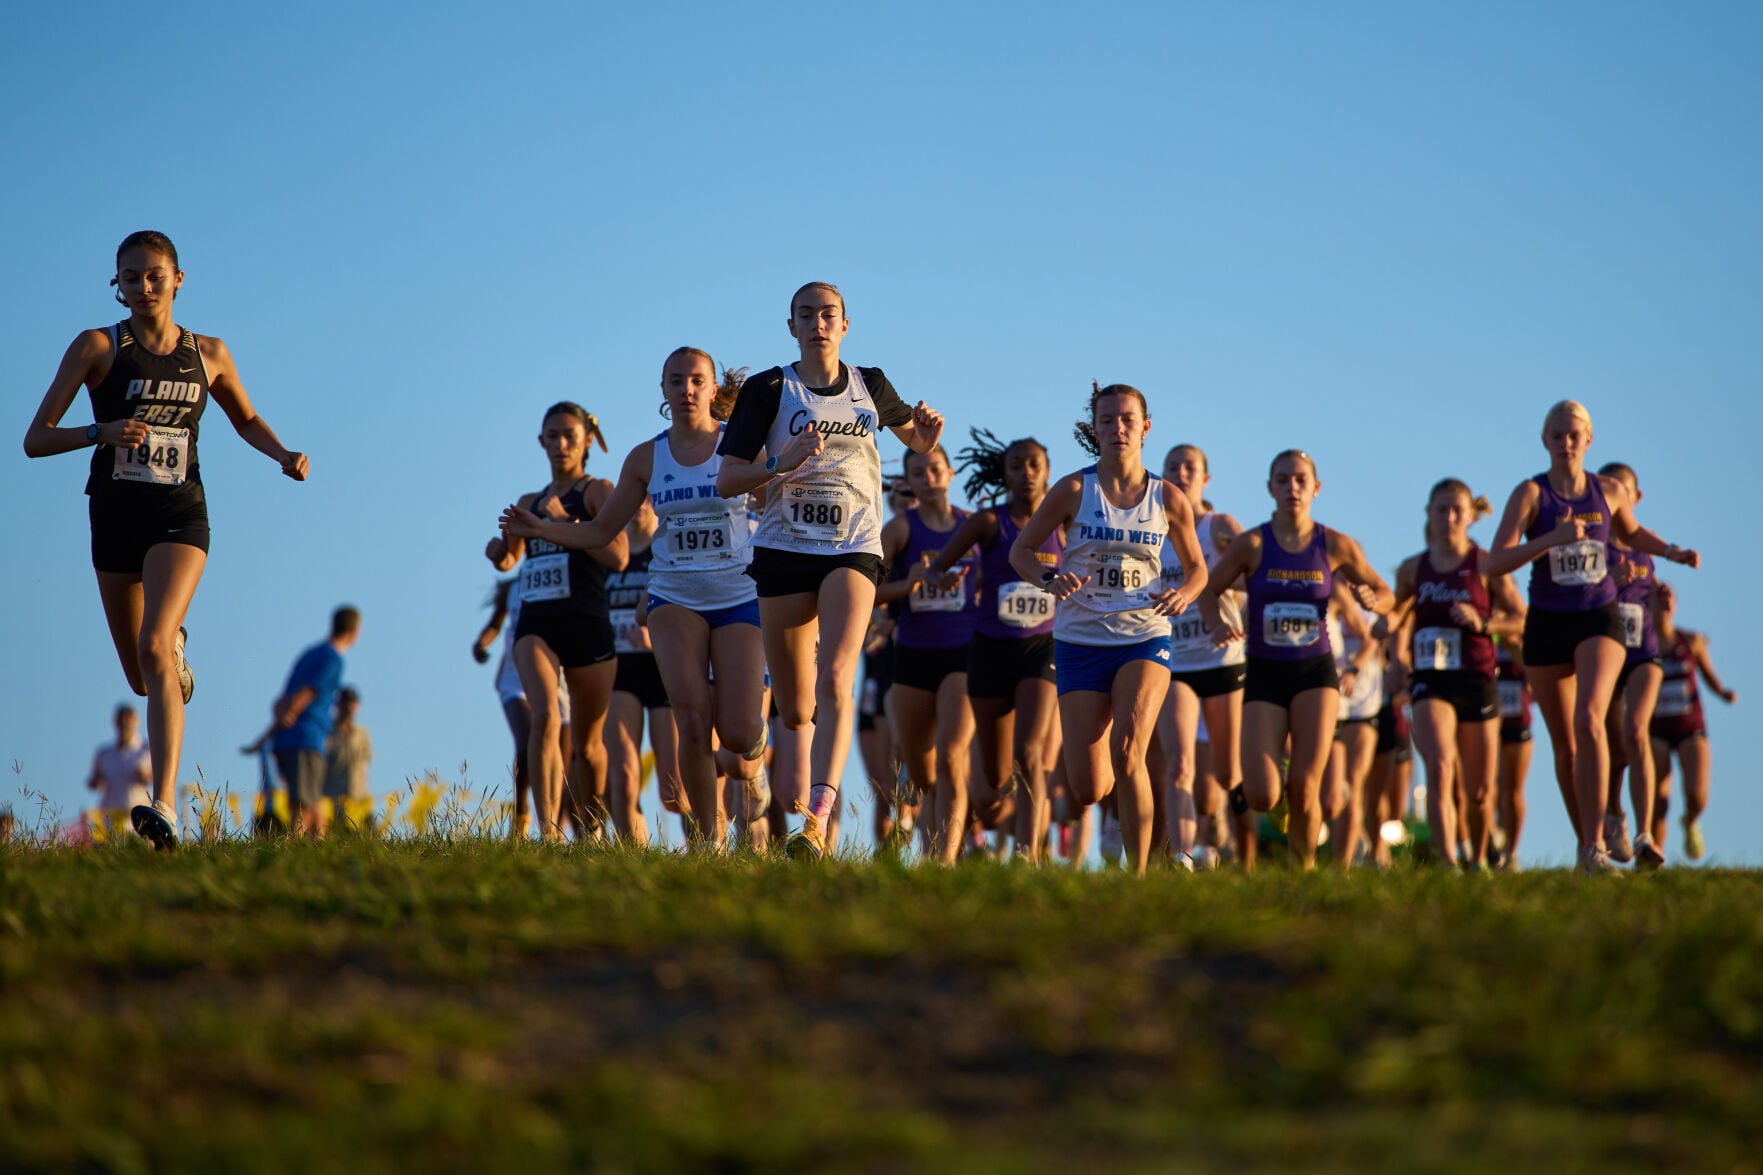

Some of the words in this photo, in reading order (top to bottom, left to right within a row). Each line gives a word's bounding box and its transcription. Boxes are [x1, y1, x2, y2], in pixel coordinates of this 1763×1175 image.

[125, 379, 200, 403] PLANO
[134, 404, 192, 425] EAST
[149, 430, 180, 438] OMPTON
[126, 444, 179, 469] 1948
[651, 486, 694, 507] PLANO
[790, 502, 842, 525] 1880
[674, 529, 724, 550] 1973
[1080, 526, 1124, 541] PLANO
[1128, 530, 1164, 547] WEST
[1557, 553, 1598, 573] 1977
[526, 568, 562, 589] 1933
[1096, 567, 1141, 588] 1966
[1005, 597, 1048, 614] 1978
